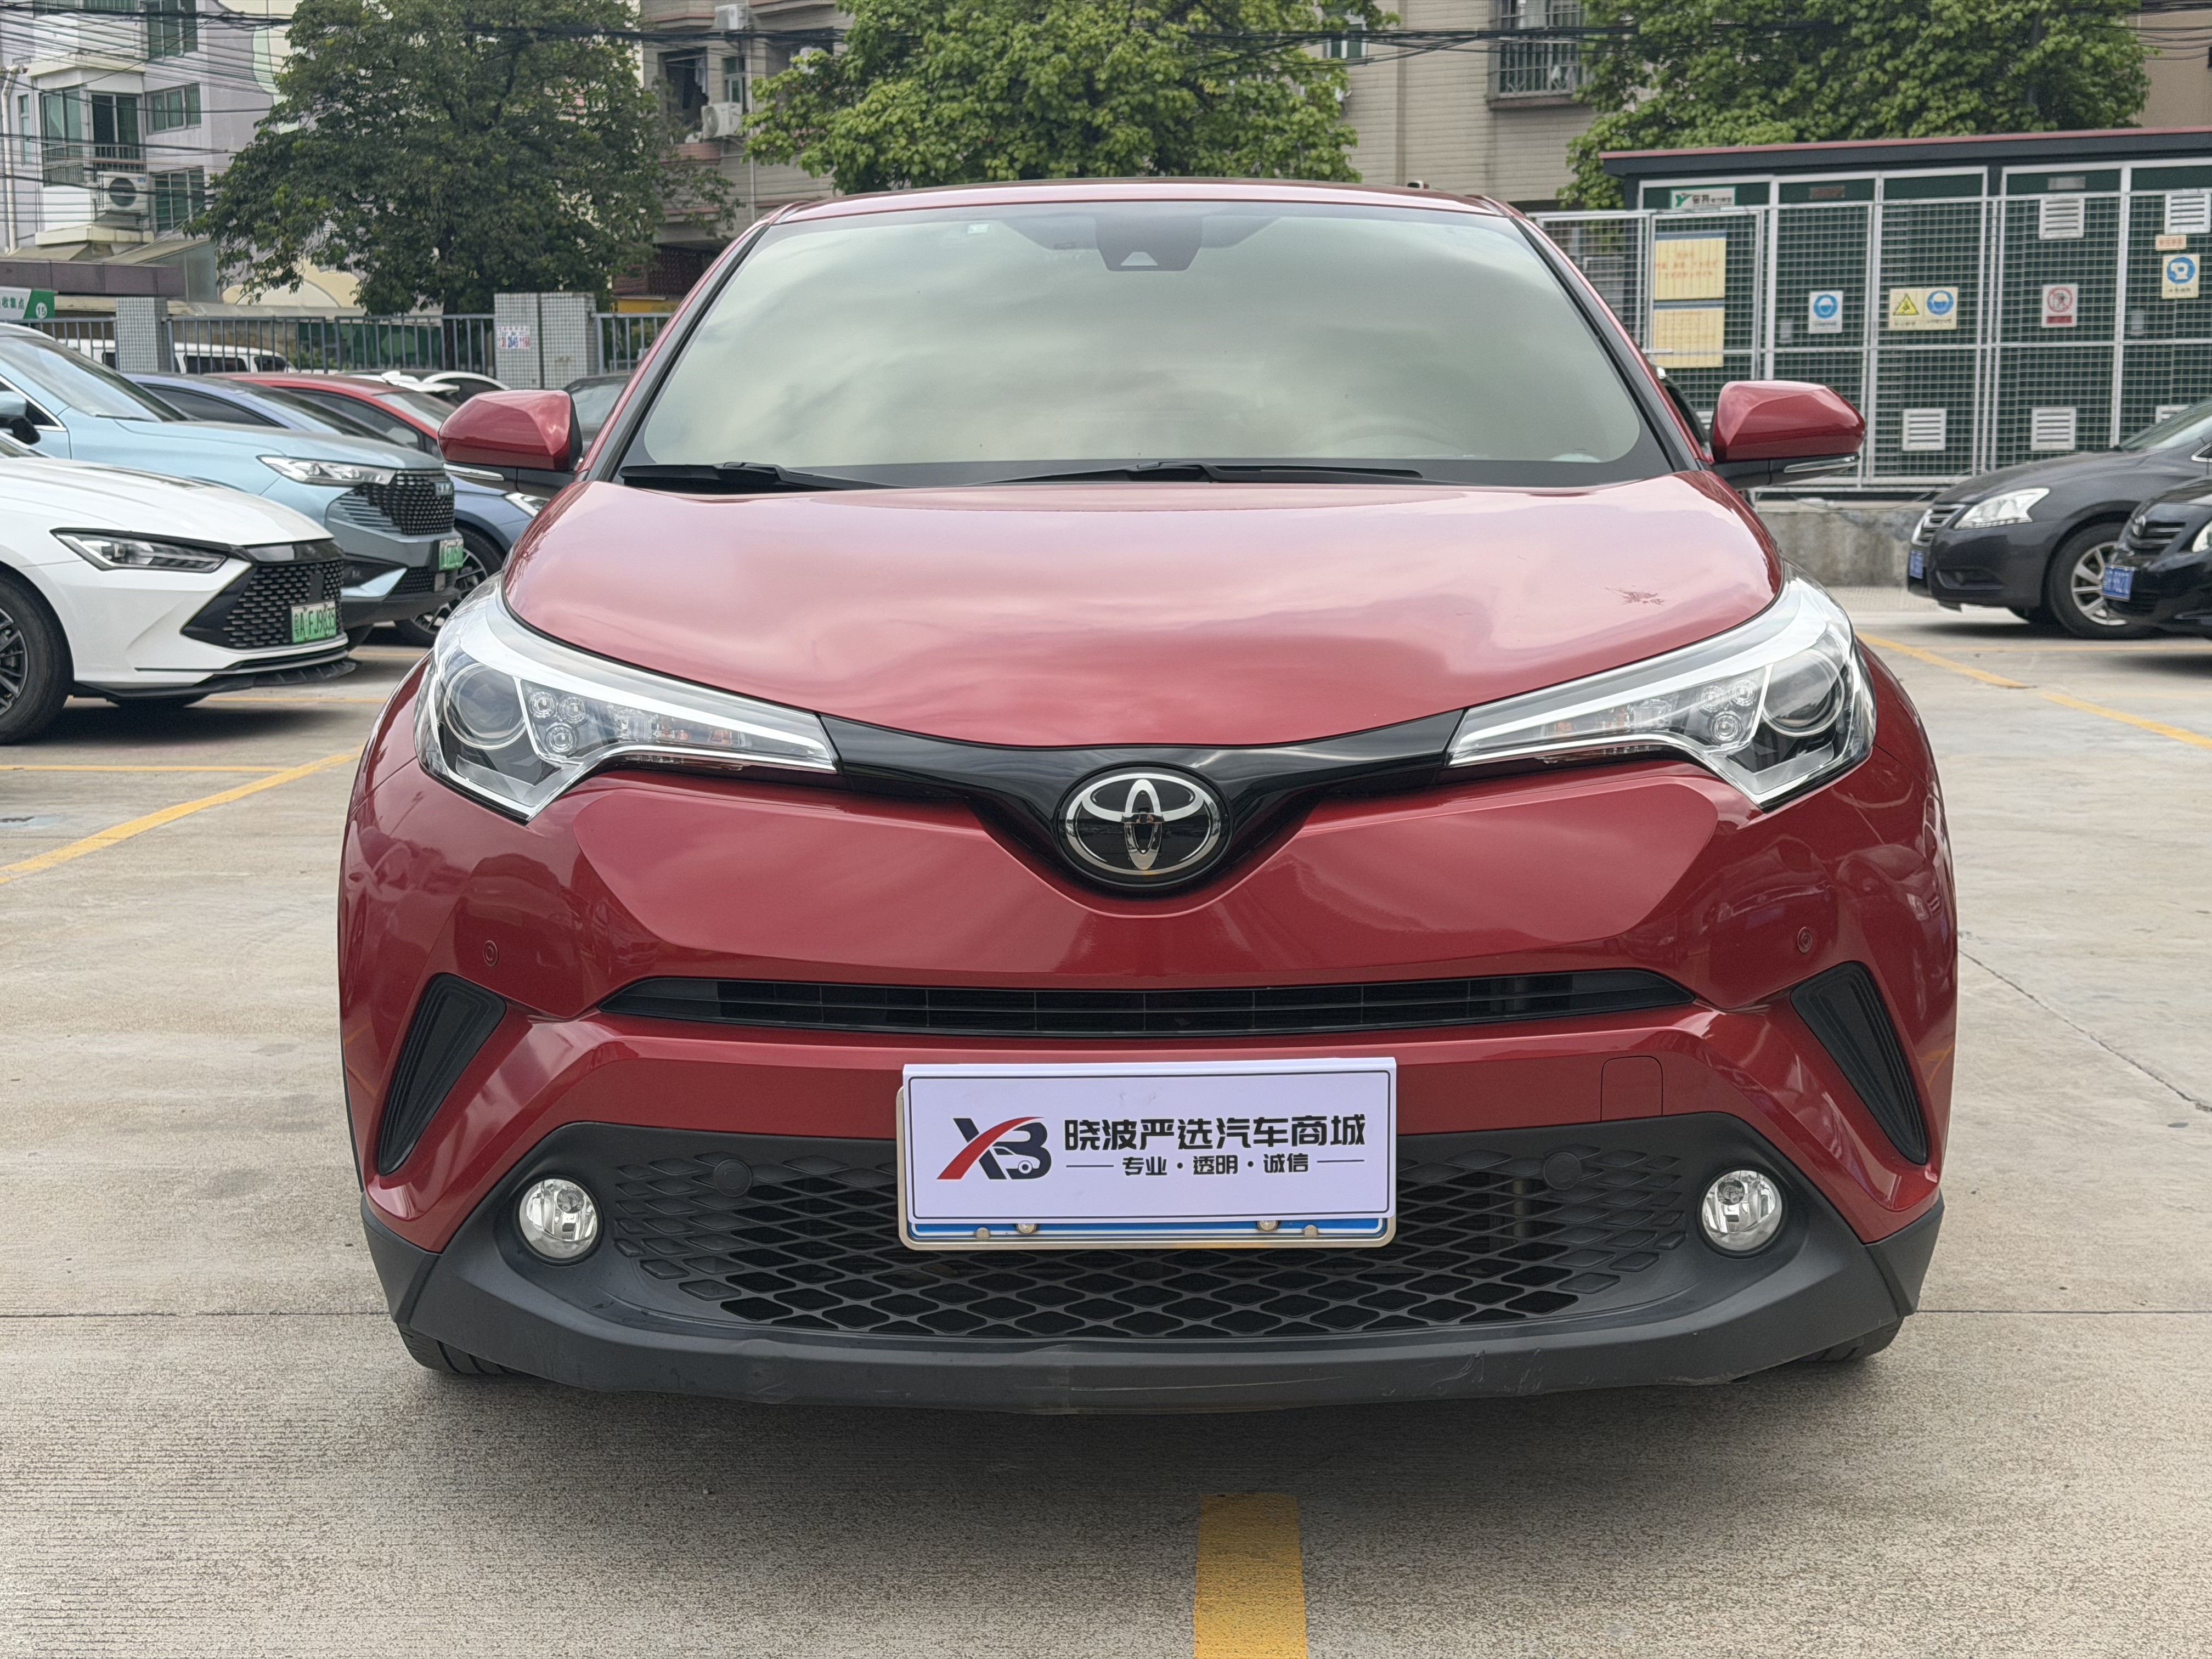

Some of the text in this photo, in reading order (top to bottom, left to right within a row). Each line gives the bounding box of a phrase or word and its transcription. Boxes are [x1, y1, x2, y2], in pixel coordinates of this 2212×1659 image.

[1064, 1114, 1365, 1150] 晓波严选汽车商城
